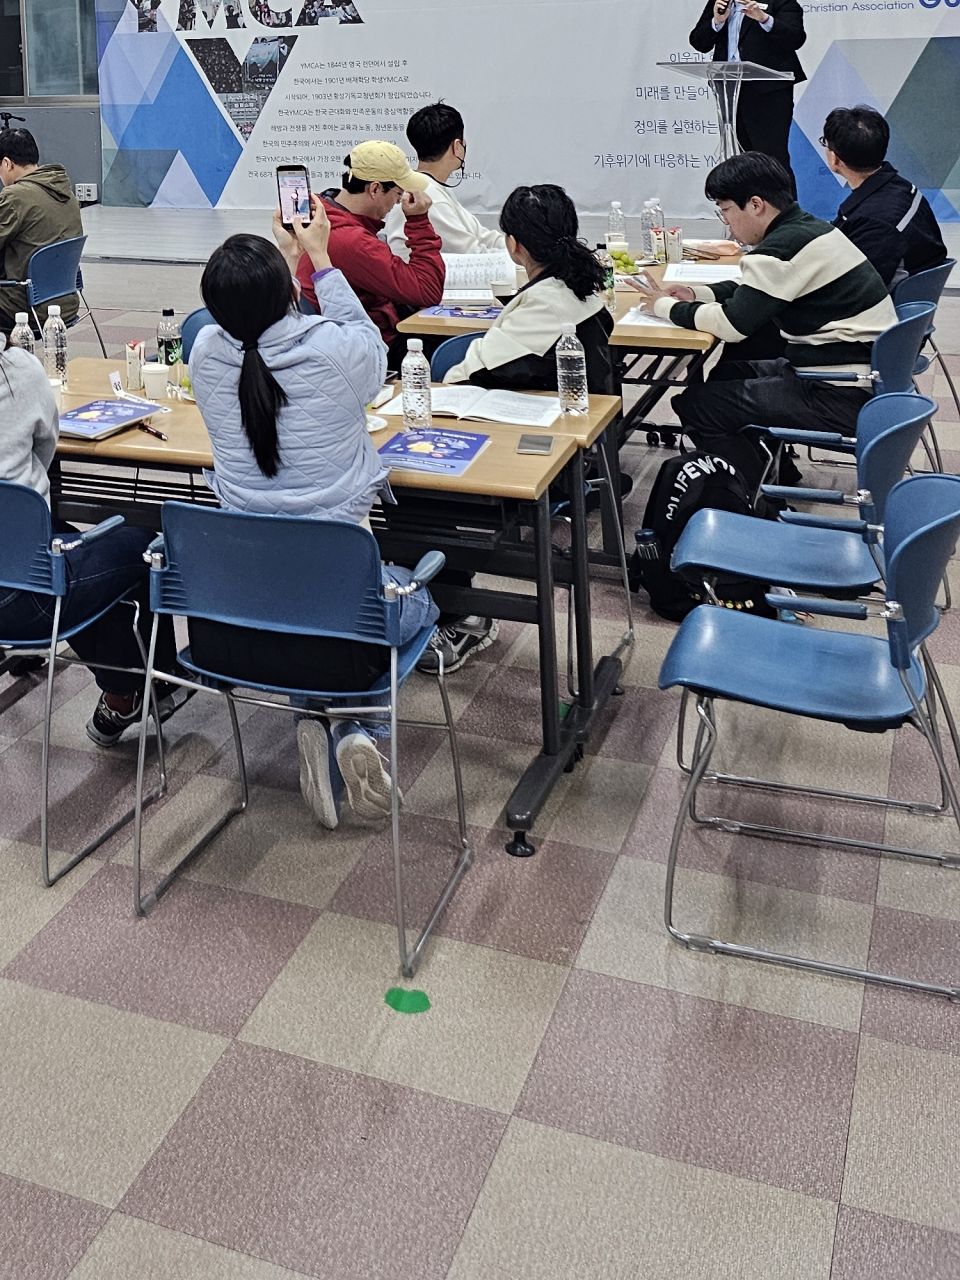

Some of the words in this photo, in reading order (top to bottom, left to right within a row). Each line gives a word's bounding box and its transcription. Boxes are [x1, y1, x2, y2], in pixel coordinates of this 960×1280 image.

[802, 2, 848, 14] Christian
[851, 0, 915, 12] Association
[636, 86, 671, 101] 미래를
[674, 86, 709, 100] 만들어
[634, 120, 668, 135] 정의를
[671, 120, 719, 134] 실현하는
[594, 154, 651, 168] 기후위기에
[654, 154, 701, 168] 대응하는
